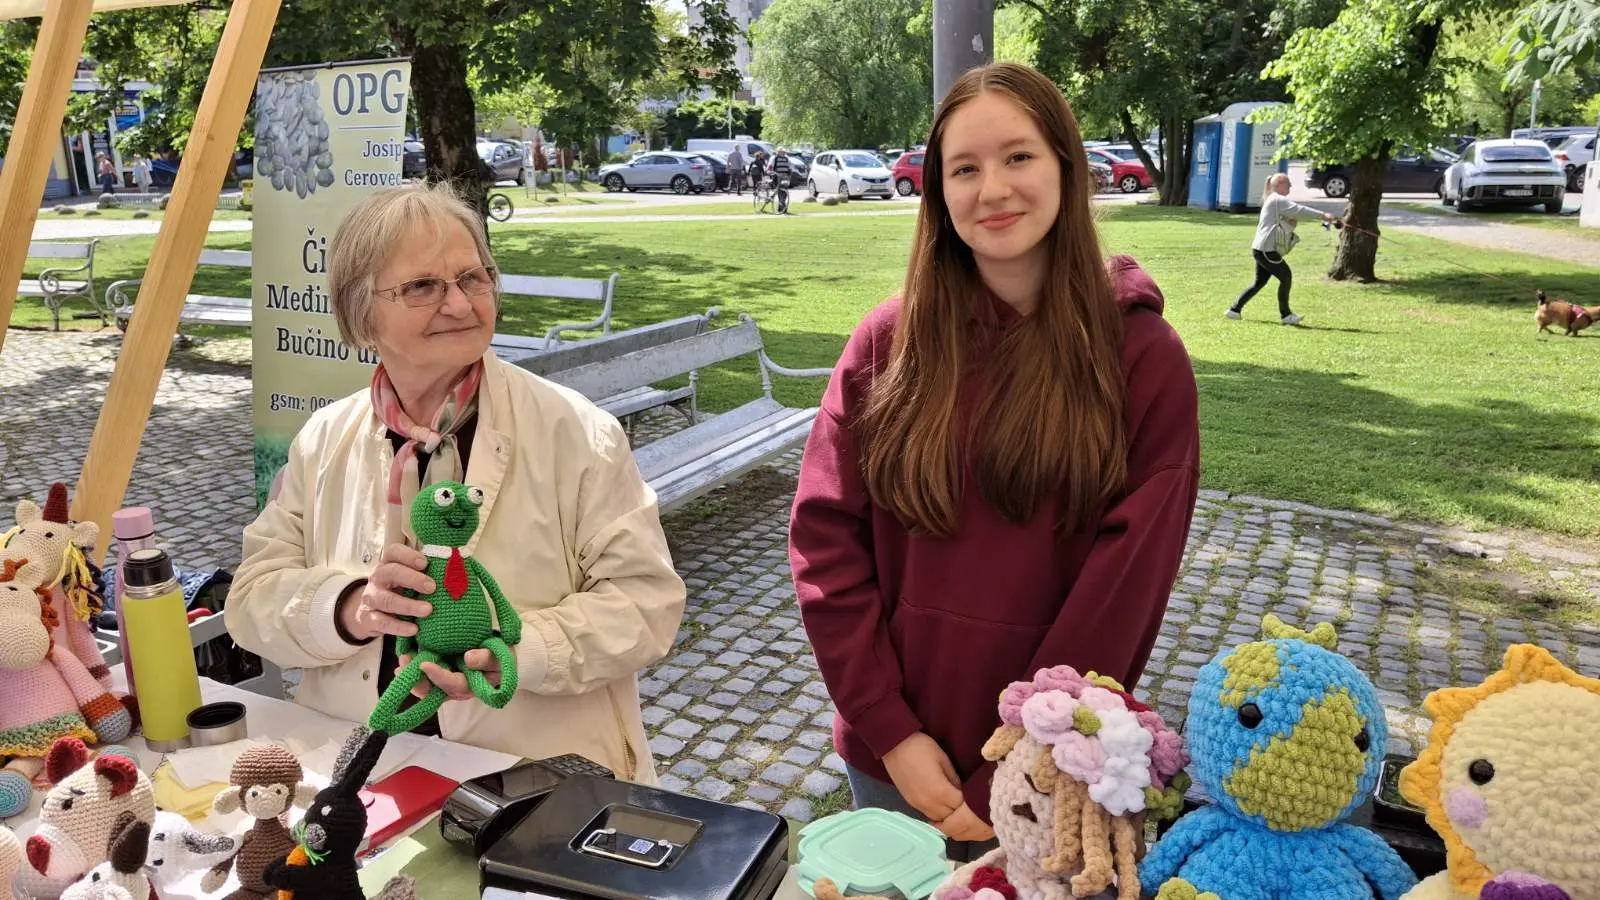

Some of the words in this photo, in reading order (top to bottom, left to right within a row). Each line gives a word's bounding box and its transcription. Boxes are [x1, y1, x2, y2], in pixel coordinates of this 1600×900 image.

[333, 69, 404, 116] OPG
[363, 138, 402, 161] Josip
[303, 227, 327, 274] Či
[276, 327, 349, 361] Bučino
[270, 393, 305, 412] gsm:
